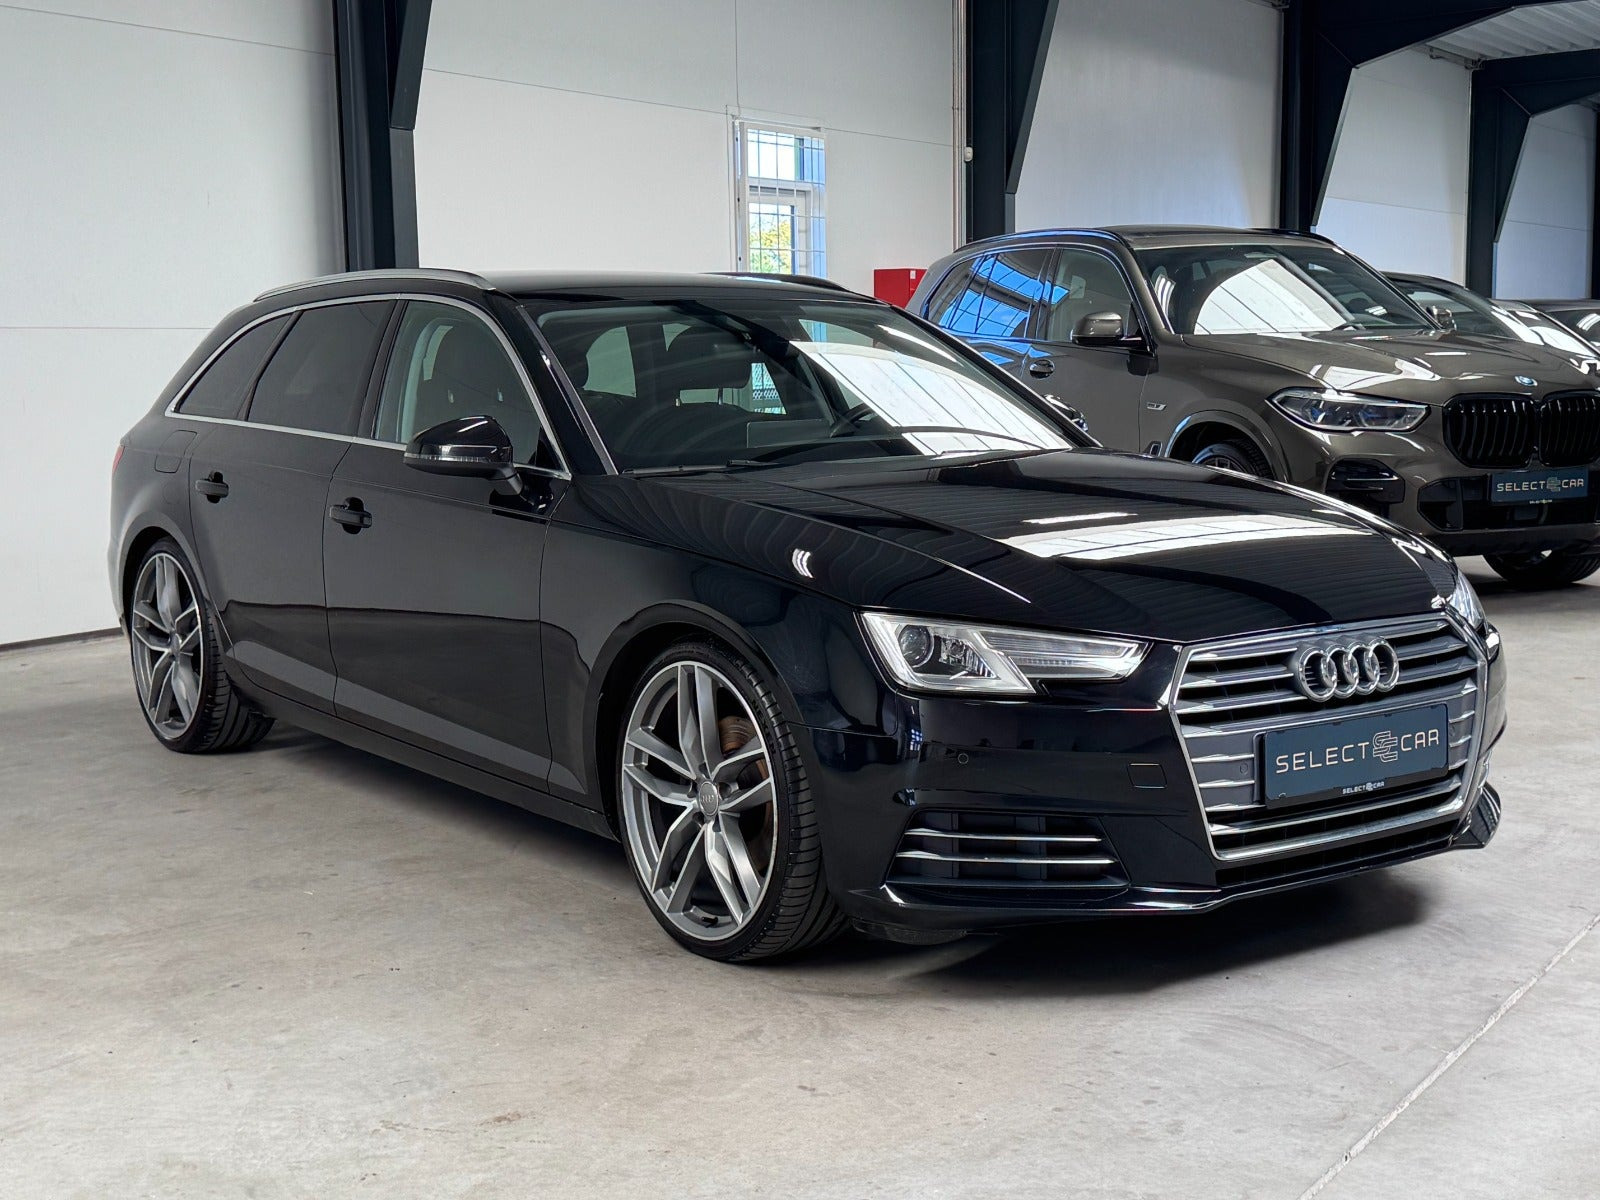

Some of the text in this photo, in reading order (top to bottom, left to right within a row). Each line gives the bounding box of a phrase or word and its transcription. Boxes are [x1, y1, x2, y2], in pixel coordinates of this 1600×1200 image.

[1496, 478, 1585, 492] SELECT CAR
[1275, 741, 1370, 774] SELECT
[1400, 728, 1440, 752] CAR
[1342, 784, 1366, 795] SELECT
